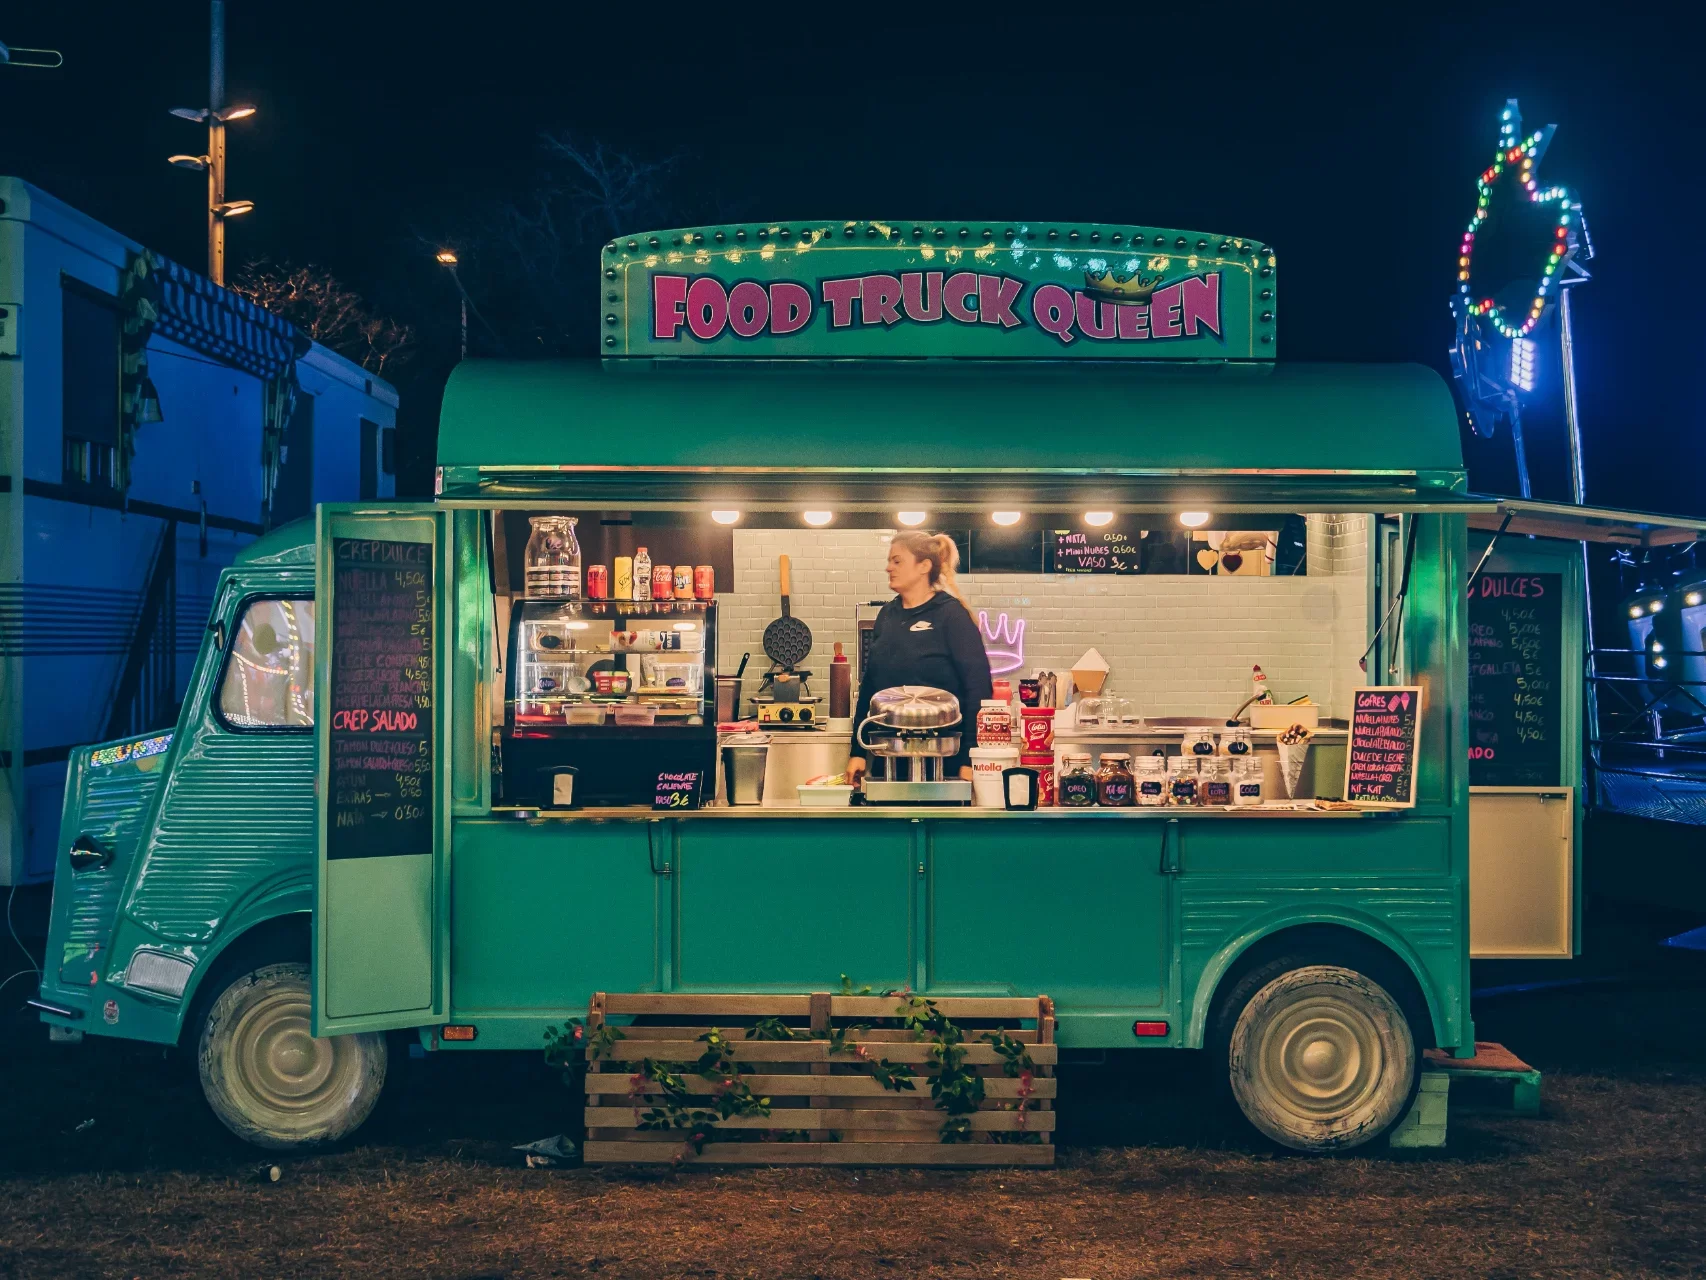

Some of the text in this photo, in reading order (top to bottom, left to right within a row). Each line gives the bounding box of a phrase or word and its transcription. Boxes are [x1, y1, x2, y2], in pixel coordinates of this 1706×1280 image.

[652, 271, 1223, 345] FOOD TRUCK QUEEN
[1078, 556, 1106, 569] VASO
[1481, 576, 1545, 598] DULCES
[333, 709, 419, 733] CREP SALADO
[985, 715, 1008, 723] nutella
[973, 763, 1002, 773] nutella
[658, 772, 698, 782] CHOCOLATE
[656, 783, 694, 791] CALIENTE
[1067, 785, 1087, 793] OREO
[1240, 785, 1258, 794] COCO
